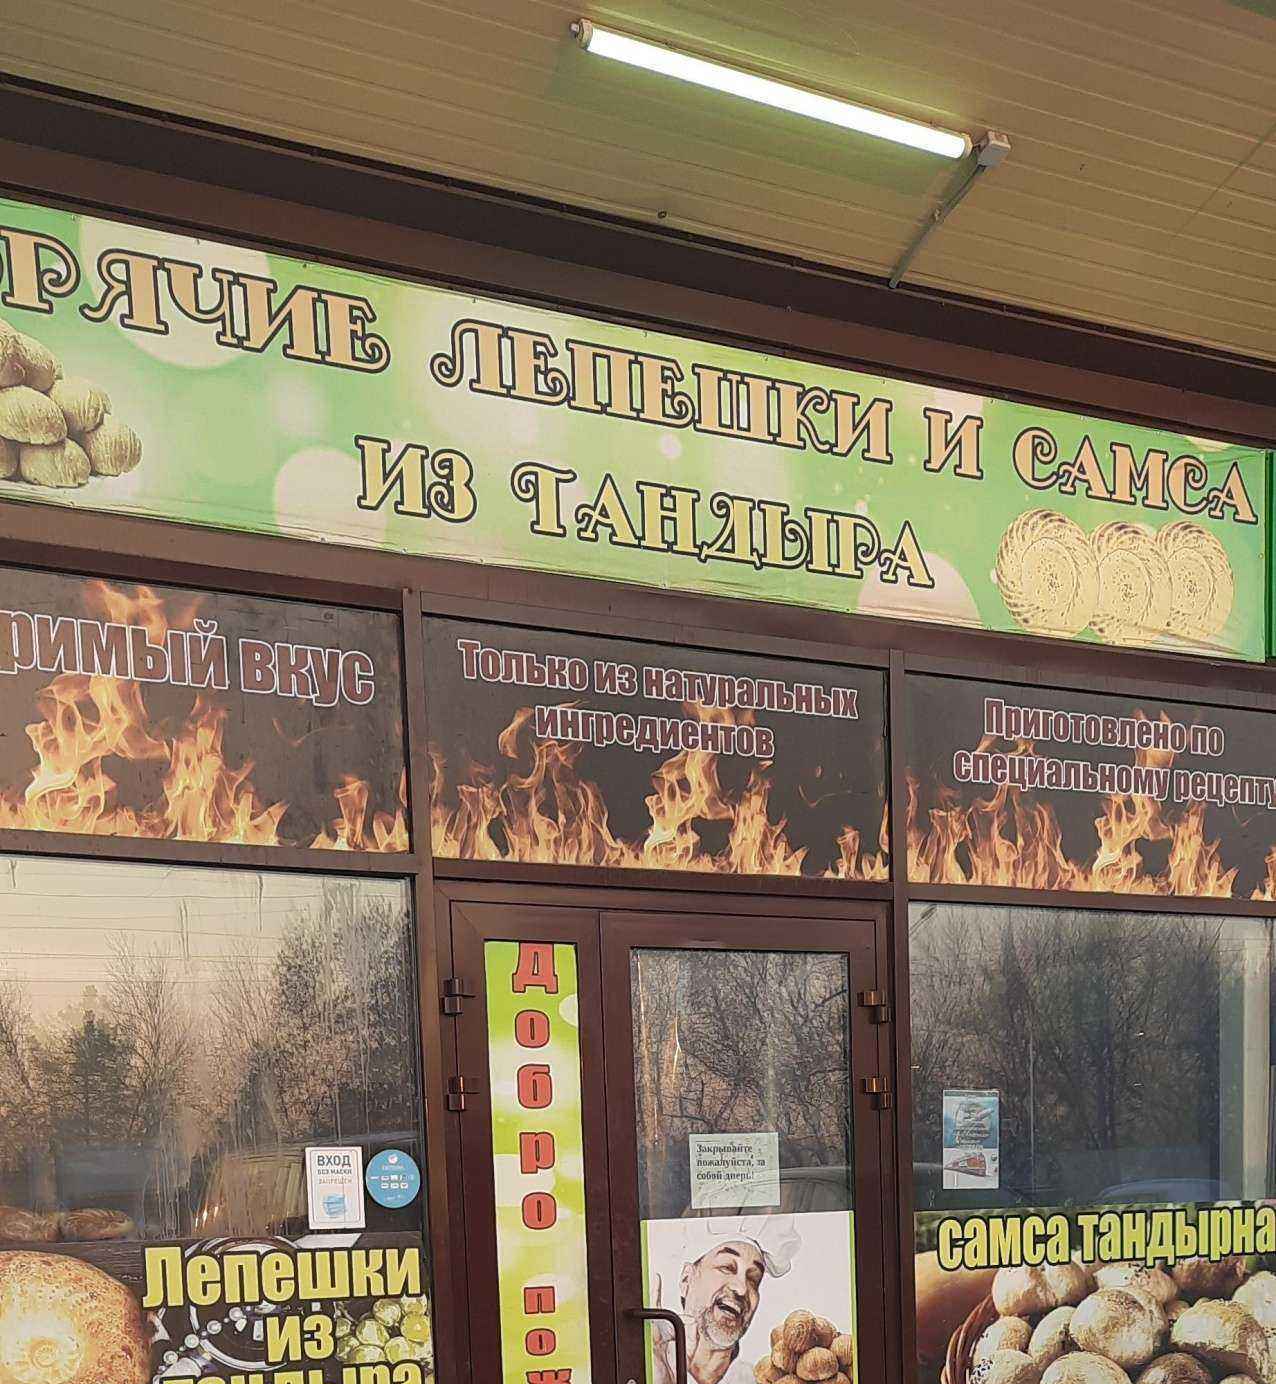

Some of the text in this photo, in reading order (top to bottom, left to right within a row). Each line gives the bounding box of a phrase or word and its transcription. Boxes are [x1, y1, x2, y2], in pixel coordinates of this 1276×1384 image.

[0, 225, 1259, 525] РЯЧИЕ ЛЕПЕШКИ И САМСА
[354, 434, 935, 588] ИЗ ТАНДЫРА
[239, 637, 375, 706] вкус
[457, 638, 859, 720] Только из натуральных
[535, 705, 775, 758] ингредиентов
[984, 697, 1225, 757] Приготовлено по
[953, 750, 1171, 801] специальному
[511, 942, 559, 1231] Добро
[317, 1155, 352, 1168] ВХОД
[938, 1205, 1276, 1271] самса тандырна
[143, 1246, 422, 1309] Лепешки
[265, 1313, 335, 1364] из
